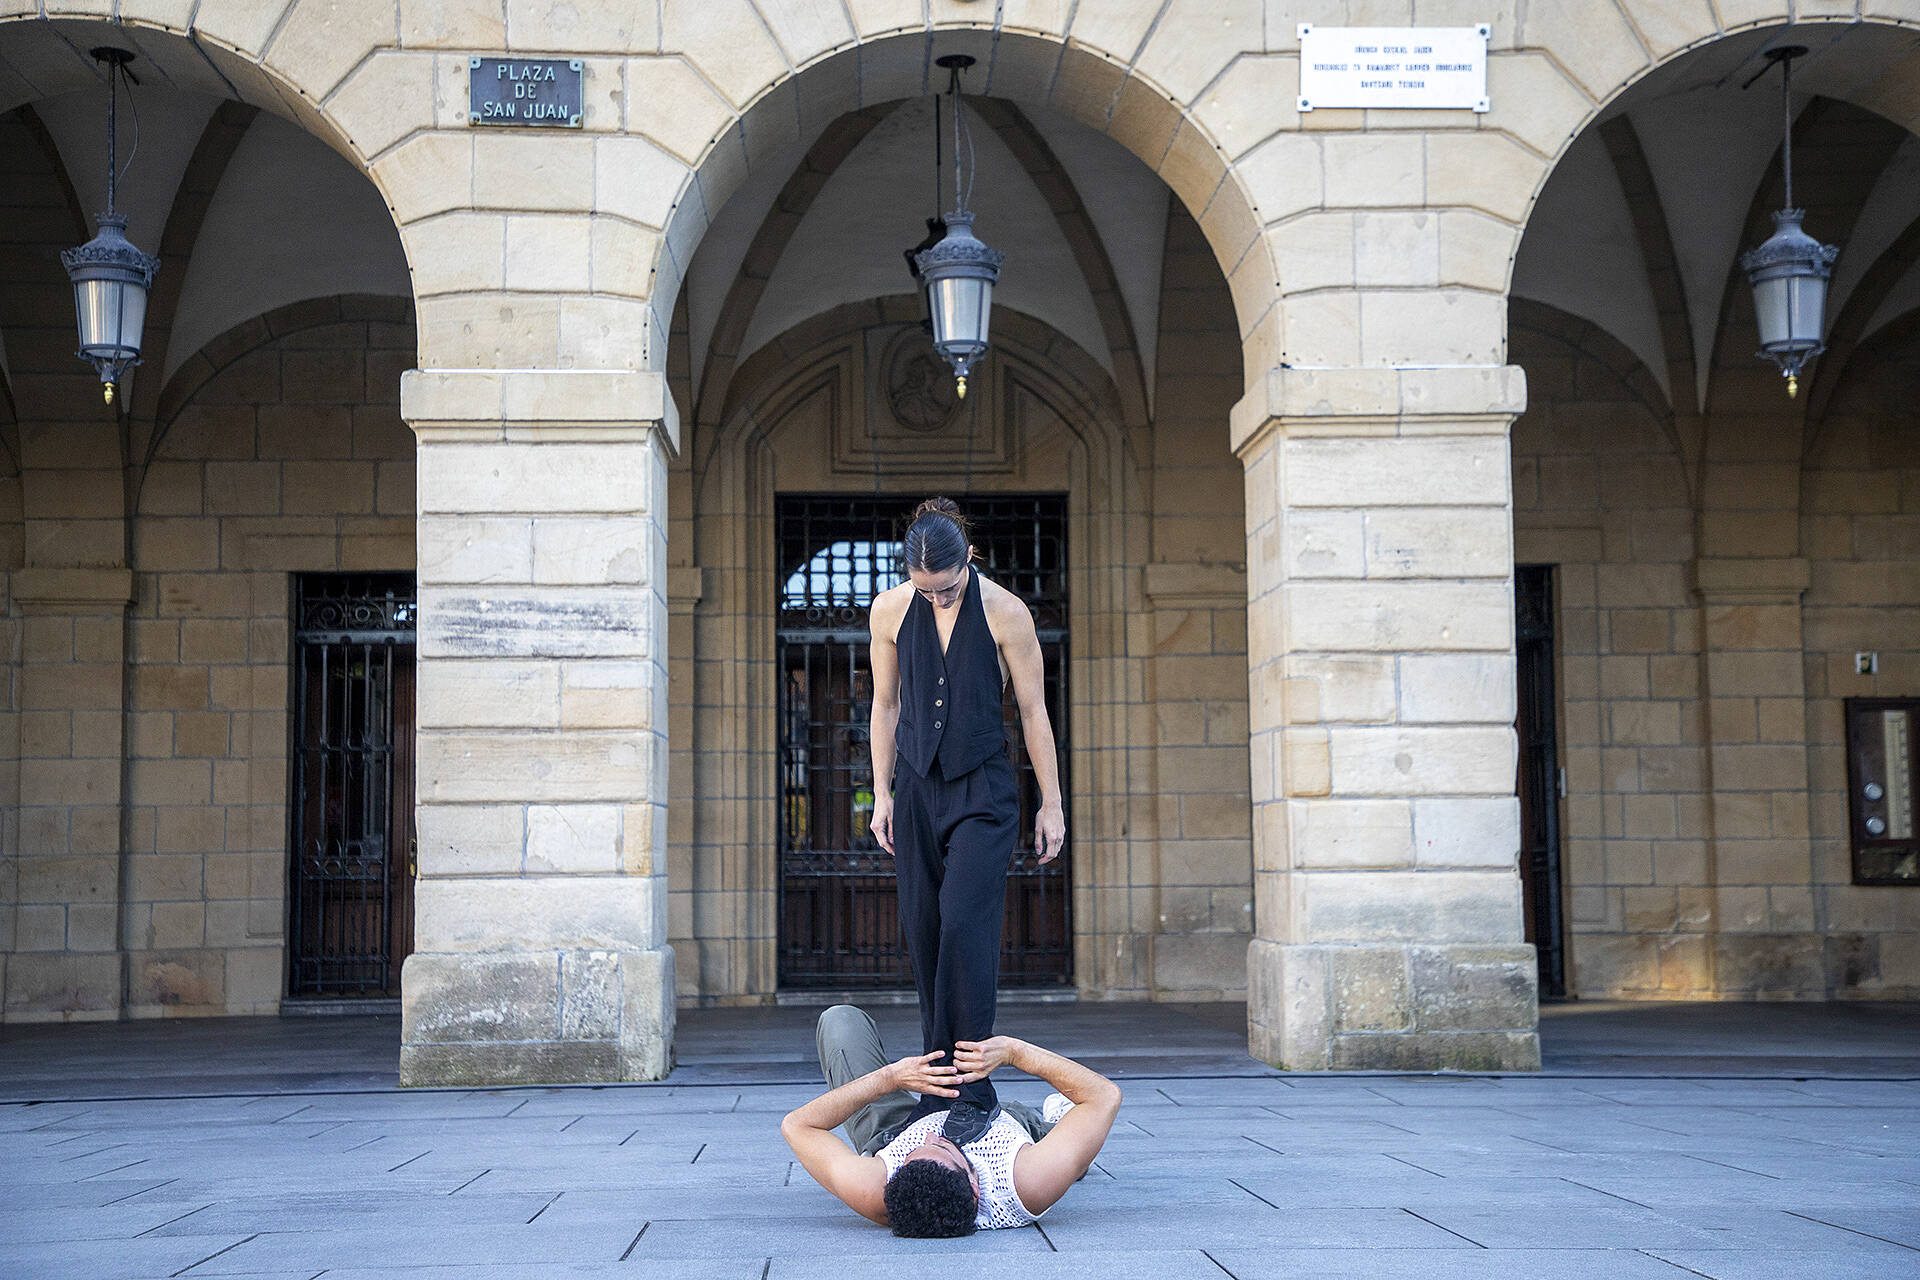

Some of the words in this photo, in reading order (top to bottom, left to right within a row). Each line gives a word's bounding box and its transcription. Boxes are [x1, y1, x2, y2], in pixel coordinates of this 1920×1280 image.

[497, 64, 555, 81] PLAZA
[515, 83, 537, 99] DE
[483, 101, 516, 118] SAN
[523, 103, 568, 120] JUAN
